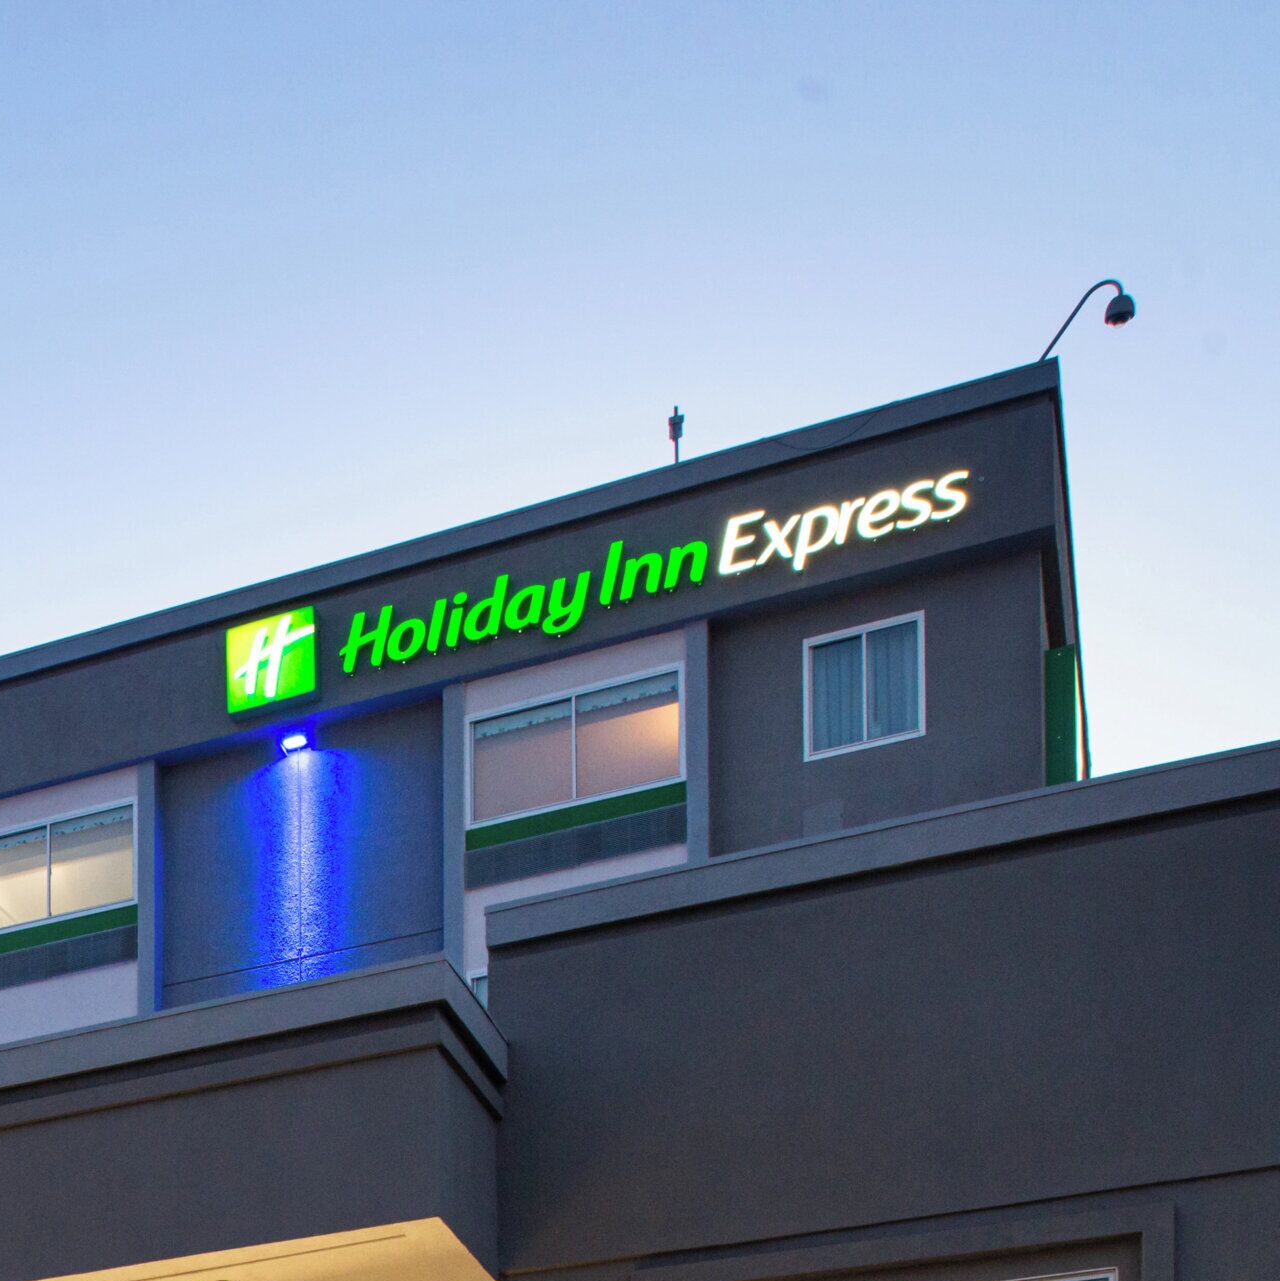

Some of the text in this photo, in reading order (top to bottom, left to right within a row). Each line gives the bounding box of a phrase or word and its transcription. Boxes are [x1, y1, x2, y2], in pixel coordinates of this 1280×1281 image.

[339, 468, 971, 674] Holiday Inn Express
